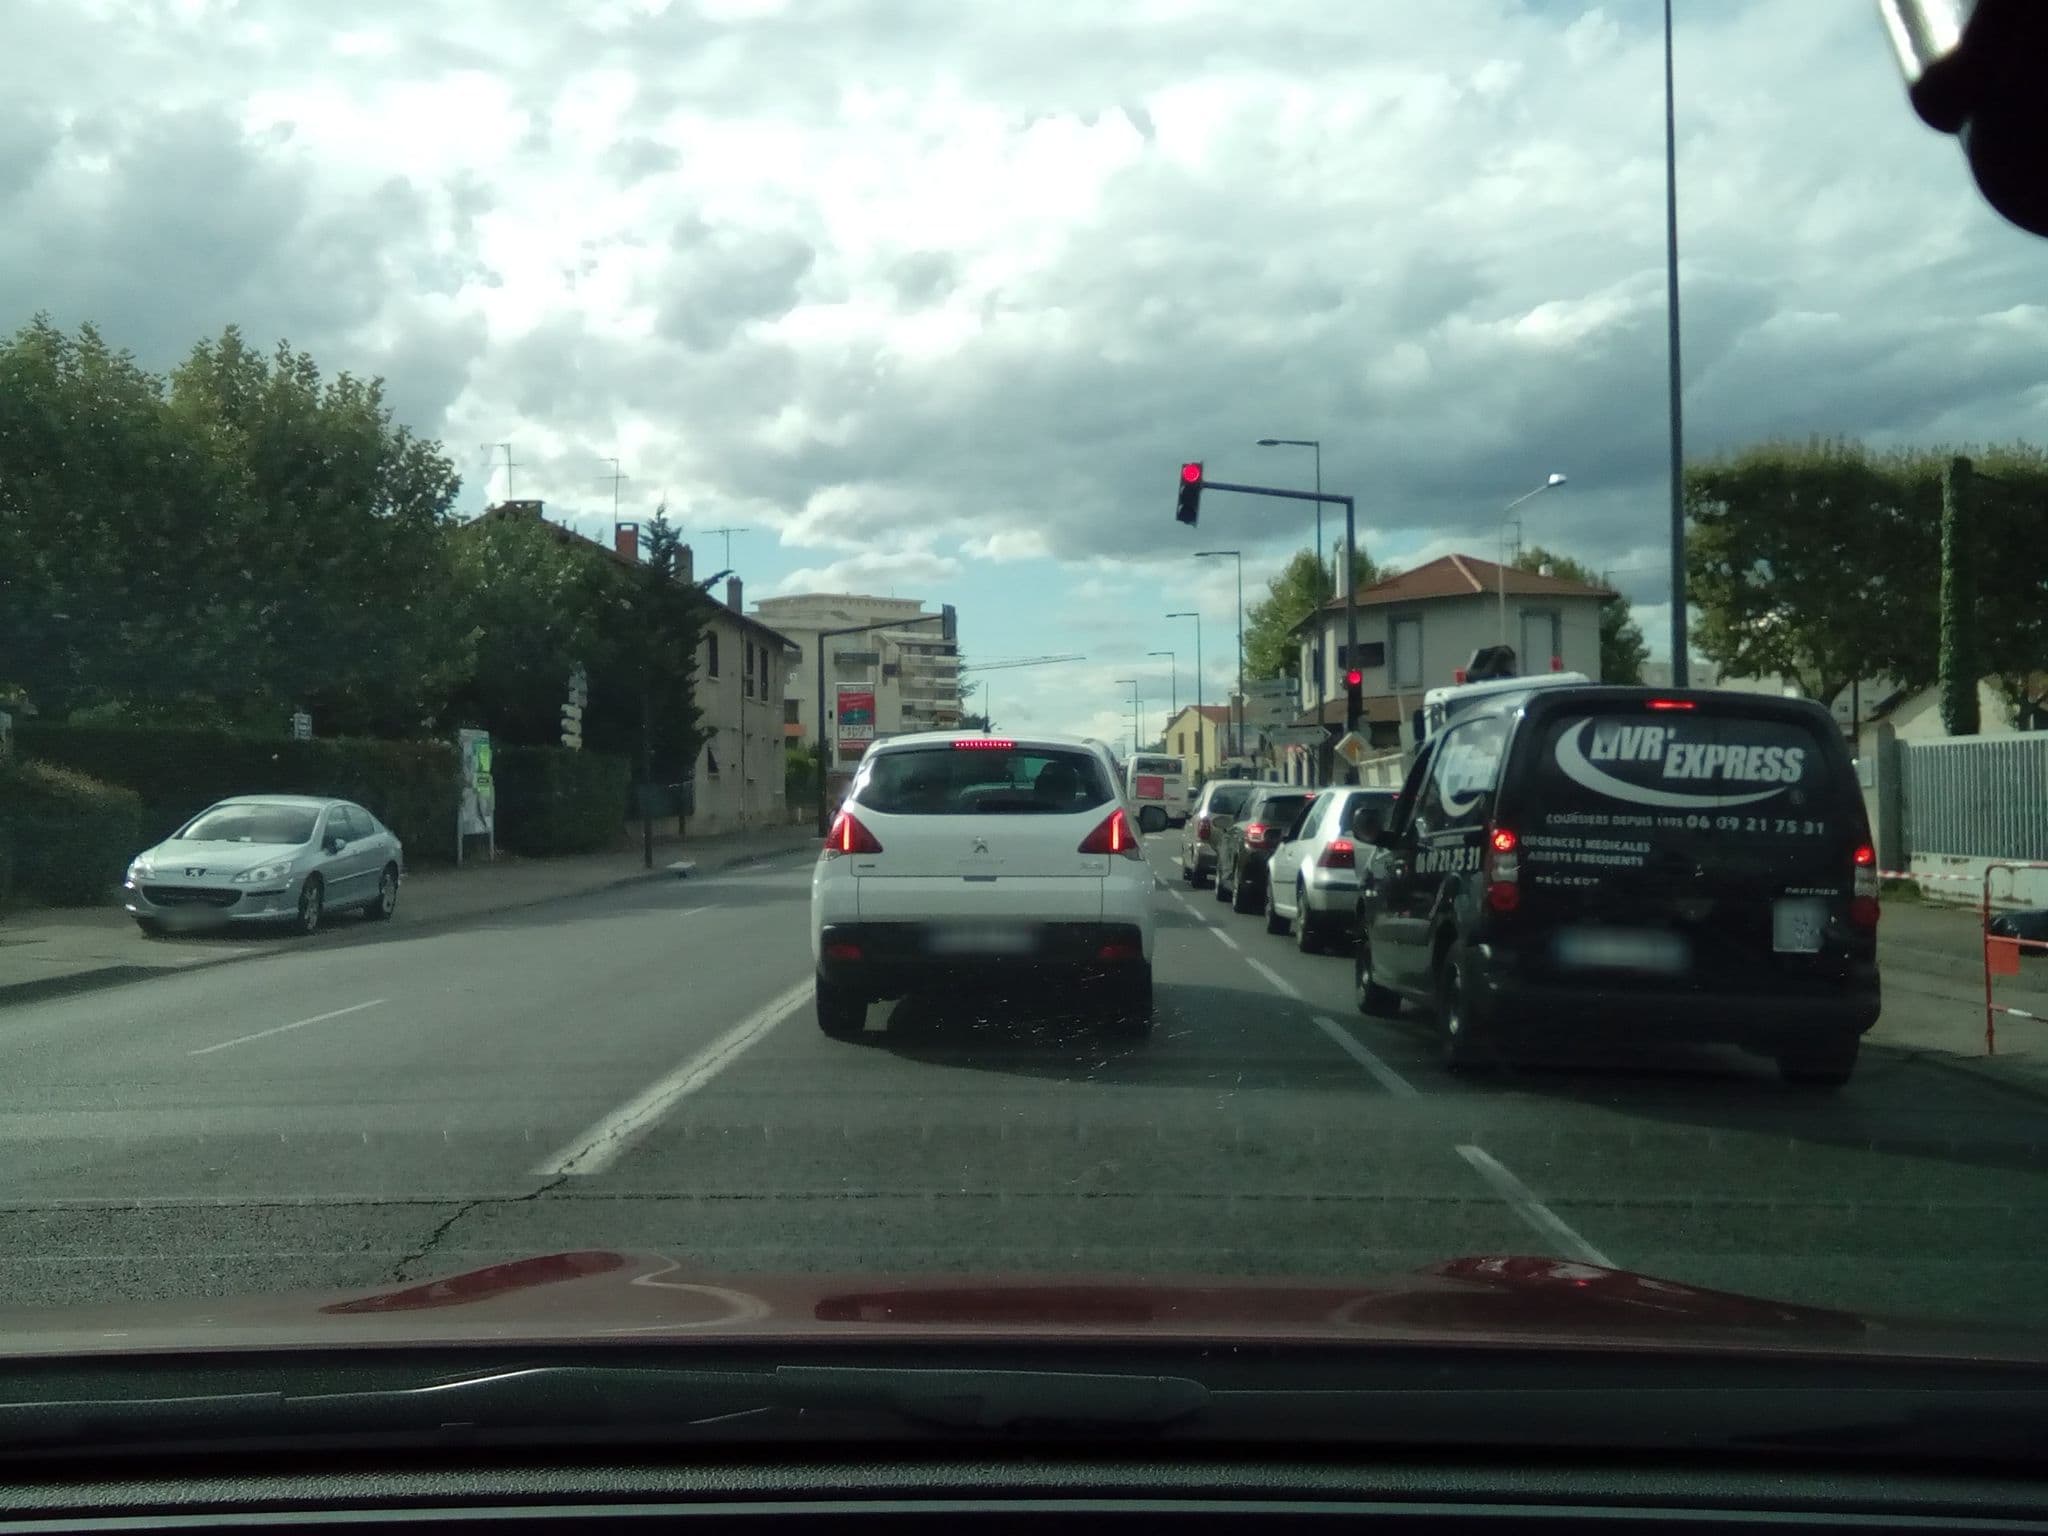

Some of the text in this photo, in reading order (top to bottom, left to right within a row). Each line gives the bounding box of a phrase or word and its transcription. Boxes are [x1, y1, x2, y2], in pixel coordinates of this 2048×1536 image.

[1663, 743, 1805, 783] EXPRESS
[1612, 815, 1653, 827] DEPUIS
[1686, 814, 1710, 830] 06
[1716, 816, 1740, 831] 09
[1746, 817, 1767, 832] 21
[1775, 819, 1797, 835] 75
[1585, 839, 1651, 853] MEDICALES
